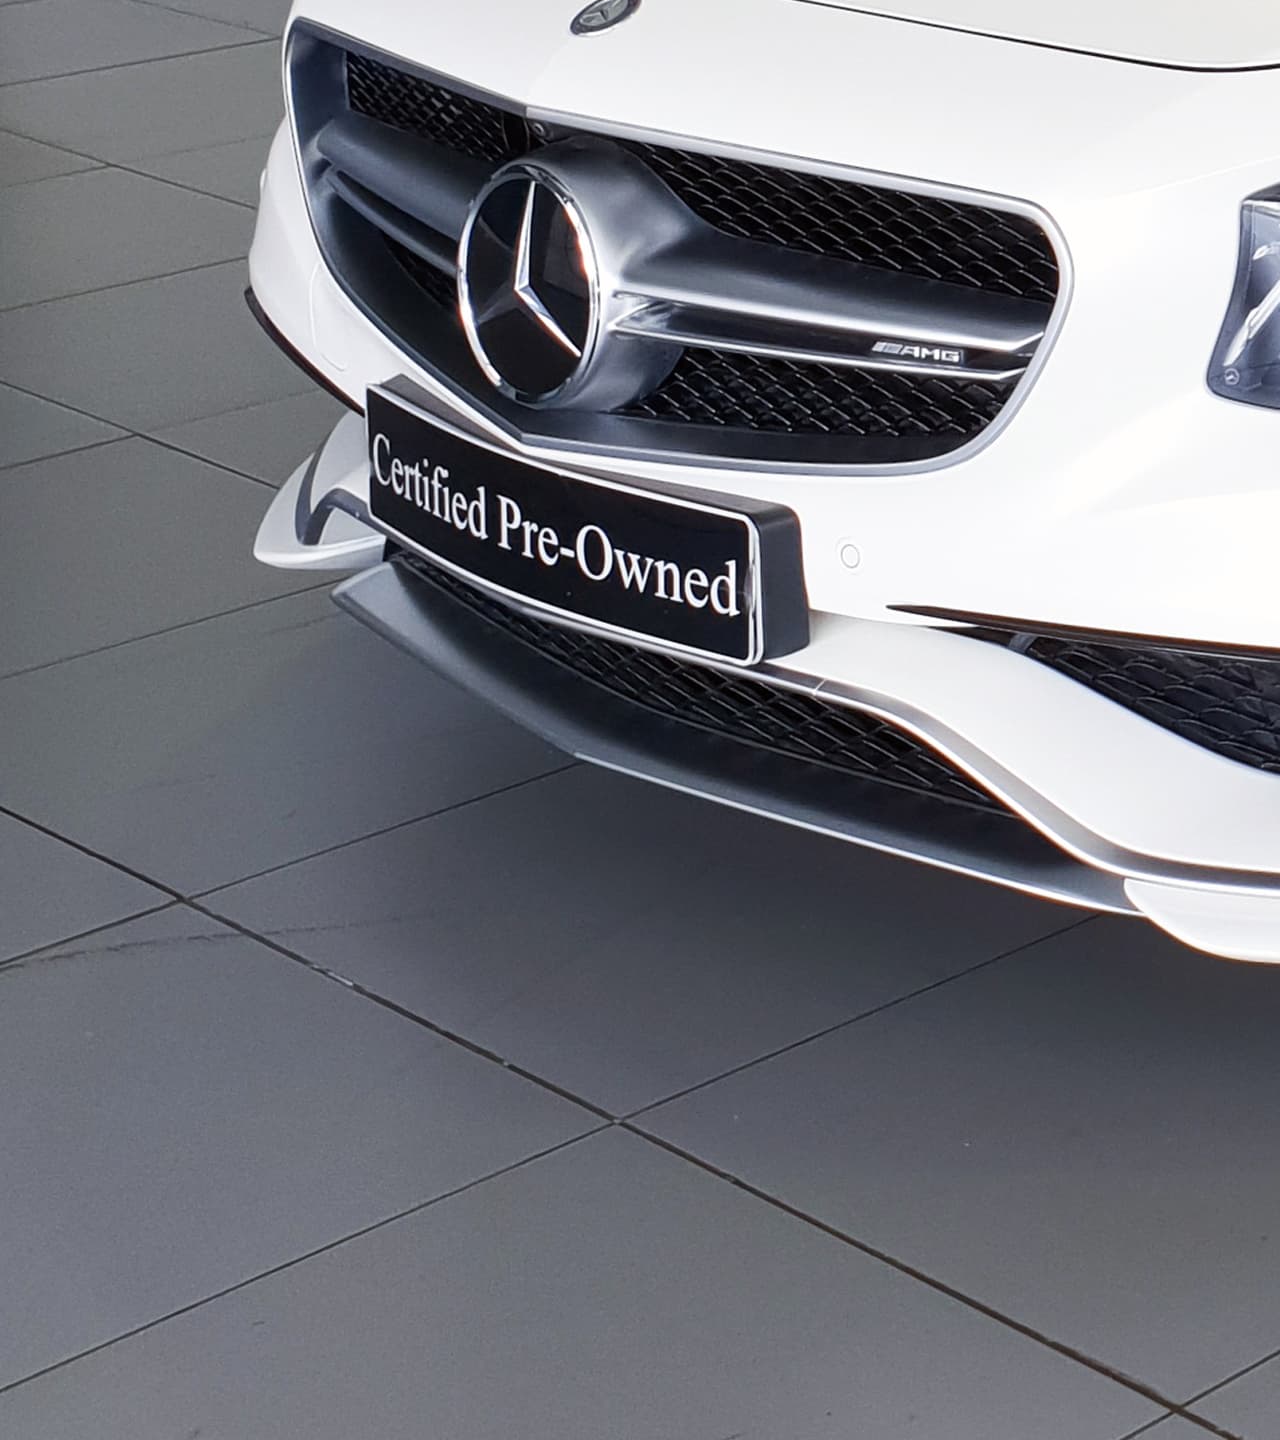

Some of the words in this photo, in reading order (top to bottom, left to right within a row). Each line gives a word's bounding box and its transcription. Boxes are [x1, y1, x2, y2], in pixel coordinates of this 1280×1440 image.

[901, 345, 960, 363] AMG
[372, 433, 490, 541] Certified
[496, 494, 741, 618] Pre-Owned
